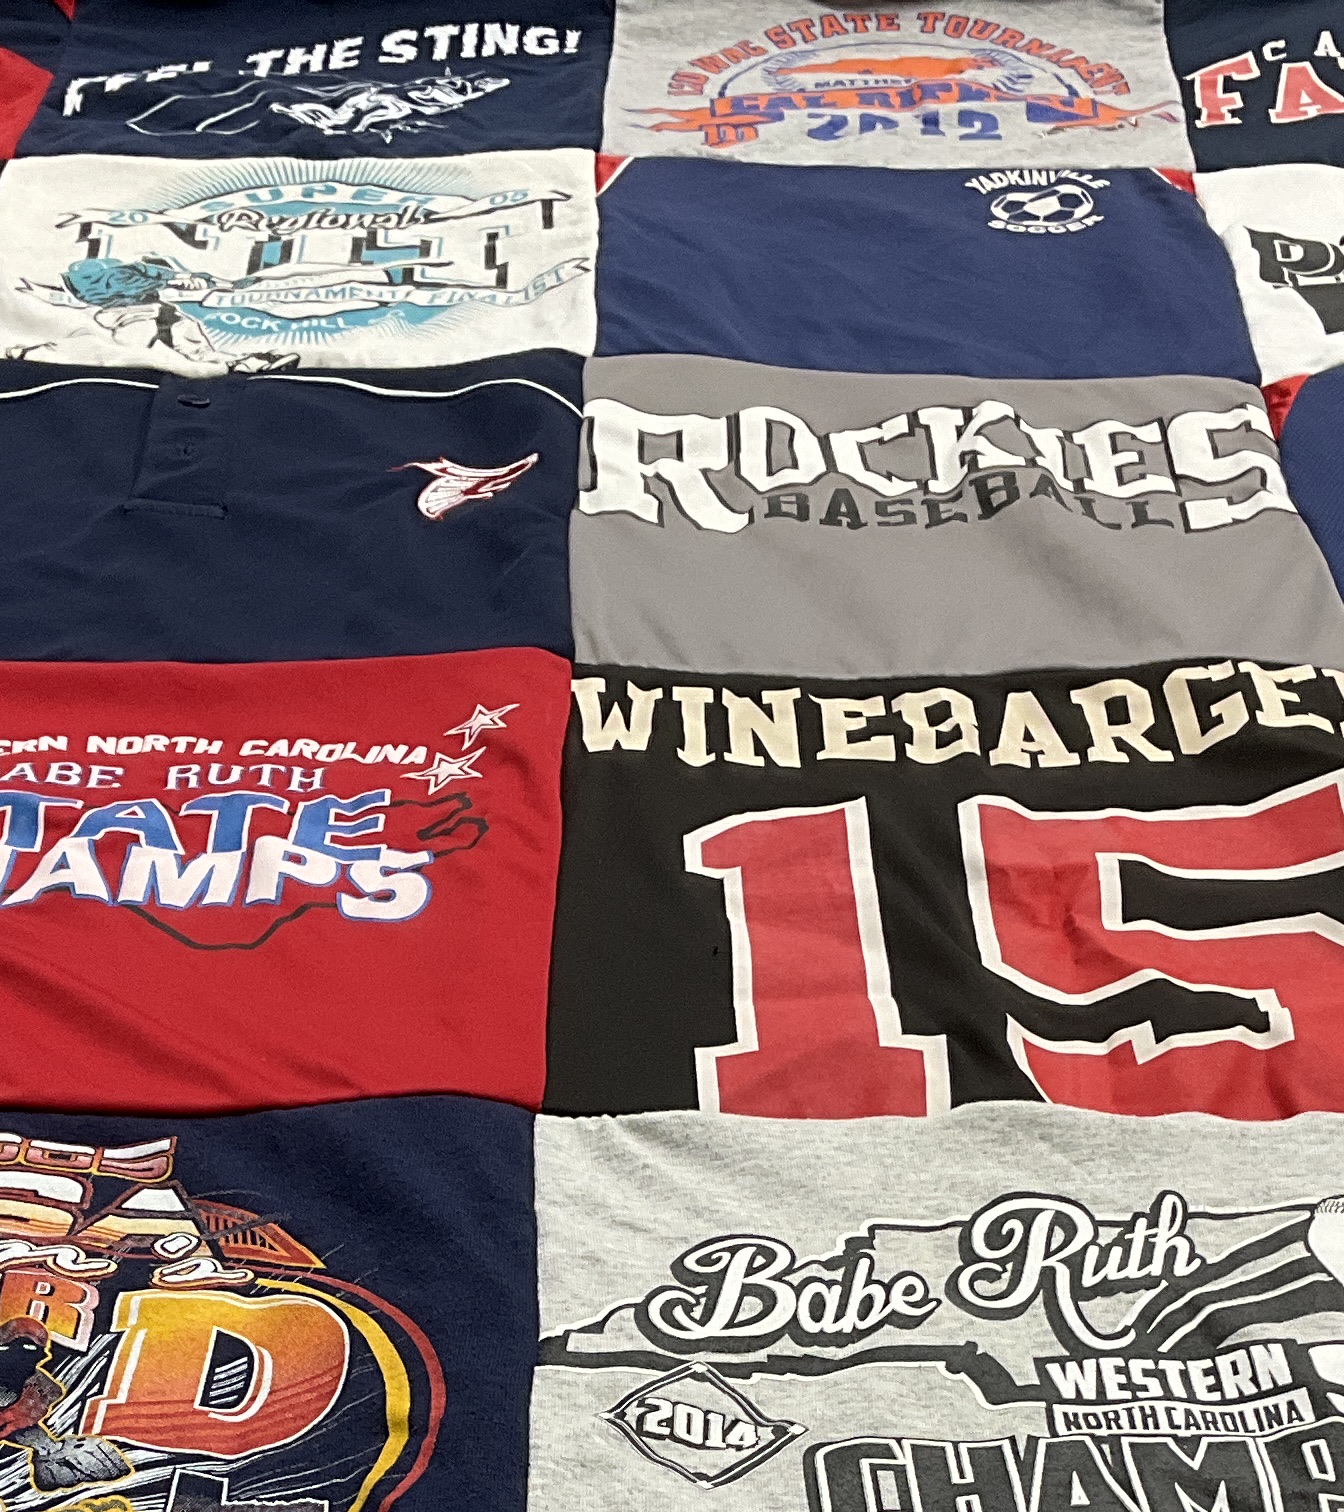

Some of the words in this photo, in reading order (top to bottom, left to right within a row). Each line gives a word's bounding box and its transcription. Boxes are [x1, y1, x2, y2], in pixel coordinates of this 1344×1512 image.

[244, 37, 365, 78] THE
[376, 22, 584, 65] STING!
[764, 13, 902, 50] STATE
[199, 182, 438, 212] SUPER
[579, 399, 1298, 534] ROCKIES
[765, 467, 1176, 531] BASEBALL
[86, 734, 223, 757] NORTH
[248, 739, 429, 768] CAROLINA
[165, 764, 330, 791] RUTH
[646, 1232, 943, 1353] Babe
[955, 1190, 1212, 1357] Ruth
[83, 1288, 355, 1461] D
[1046, 1338, 1295, 1407] WESTERN
[630, 1394, 774, 1457] 2014
[1057, 1404, 1162, 1436] NORTH
[1164, 1398, 1310, 1434] CAROLINA
